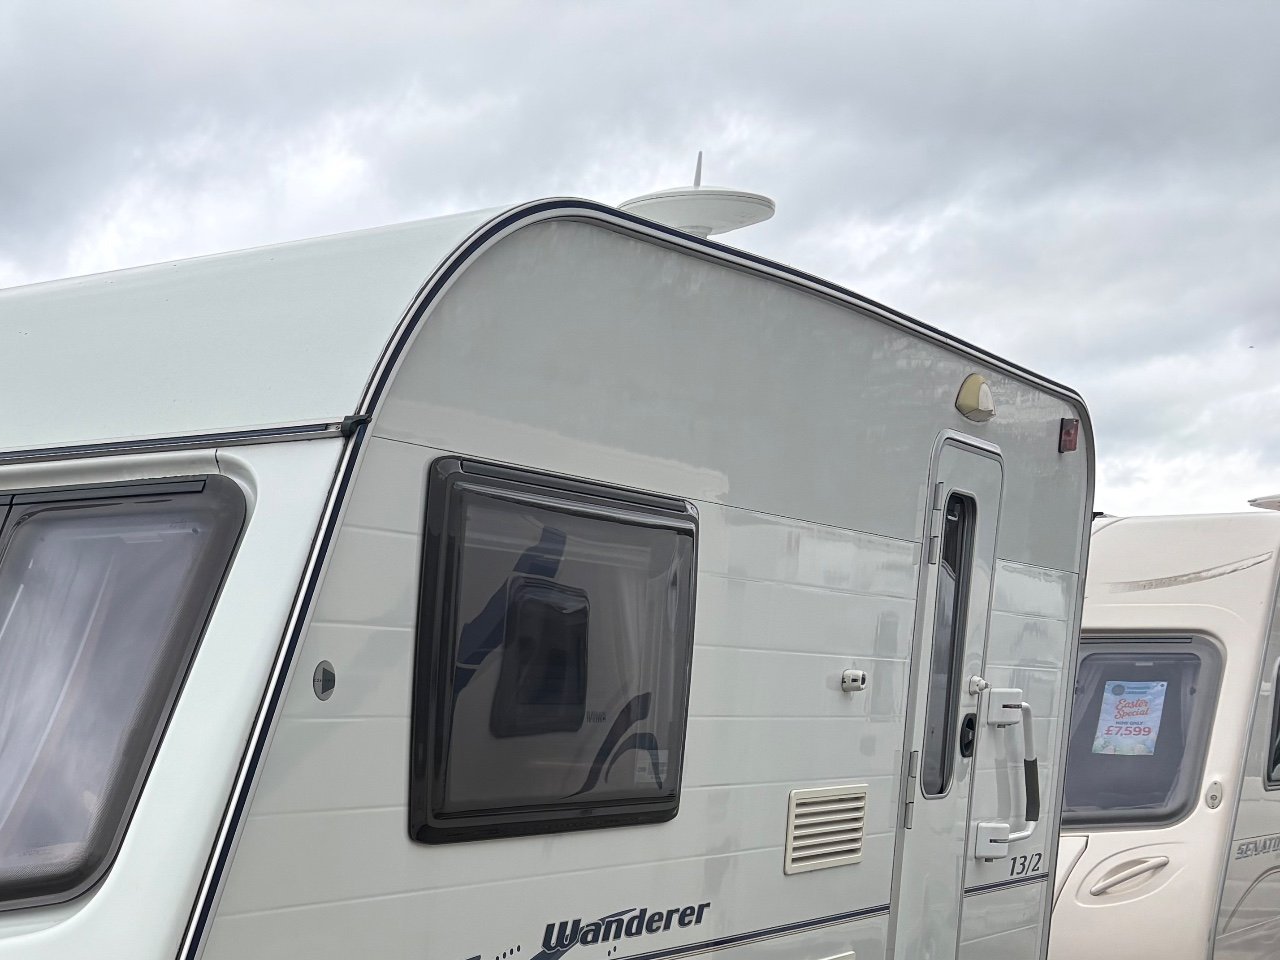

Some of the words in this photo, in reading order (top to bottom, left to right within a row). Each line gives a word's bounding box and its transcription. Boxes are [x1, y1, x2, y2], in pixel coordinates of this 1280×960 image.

[1114, 708, 1150, 720] Special
[1115, 698, 1149, 711] Easter
[1009, 852, 1043, 877] 13/2
[541, 901, 712, 954] Wanderer
